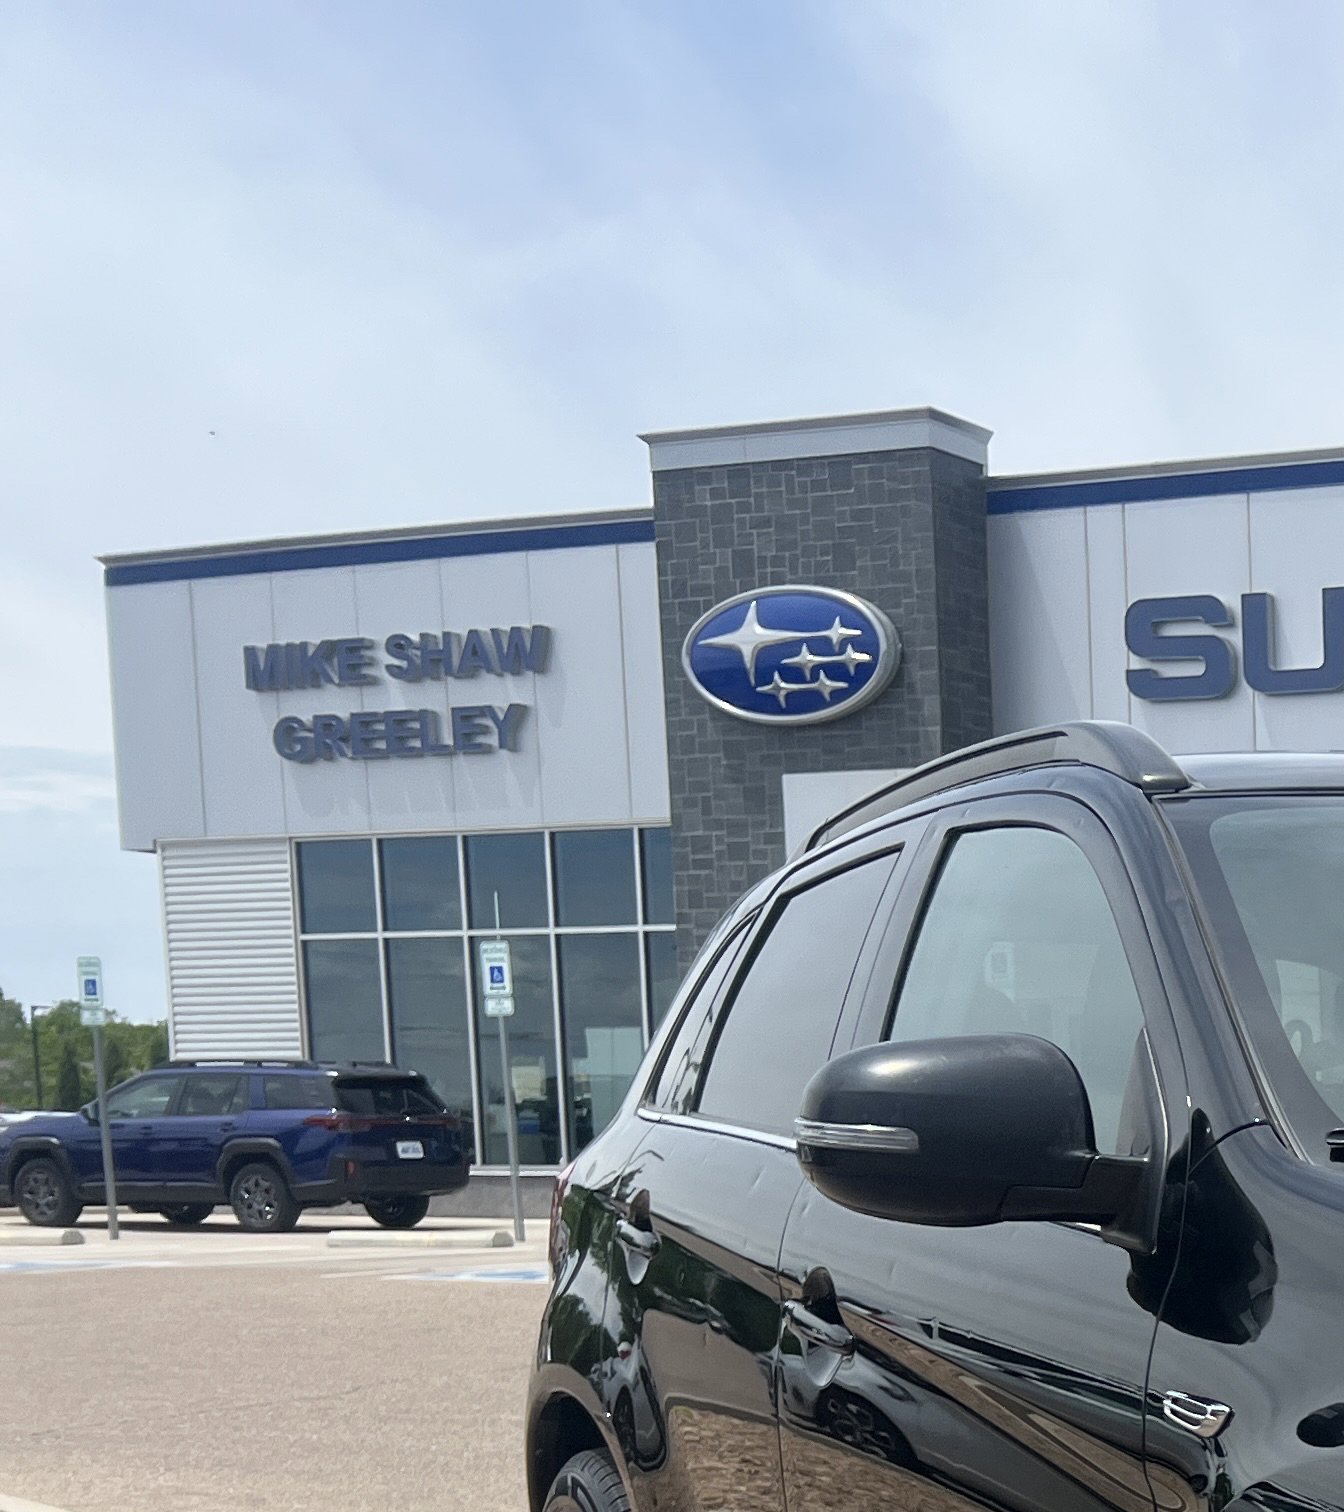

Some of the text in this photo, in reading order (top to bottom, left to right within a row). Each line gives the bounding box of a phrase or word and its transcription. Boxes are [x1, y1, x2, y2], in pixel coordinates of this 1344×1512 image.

[244, 625, 551, 691] MIKE SHAW
[273, 703, 529, 763] GREELEY
